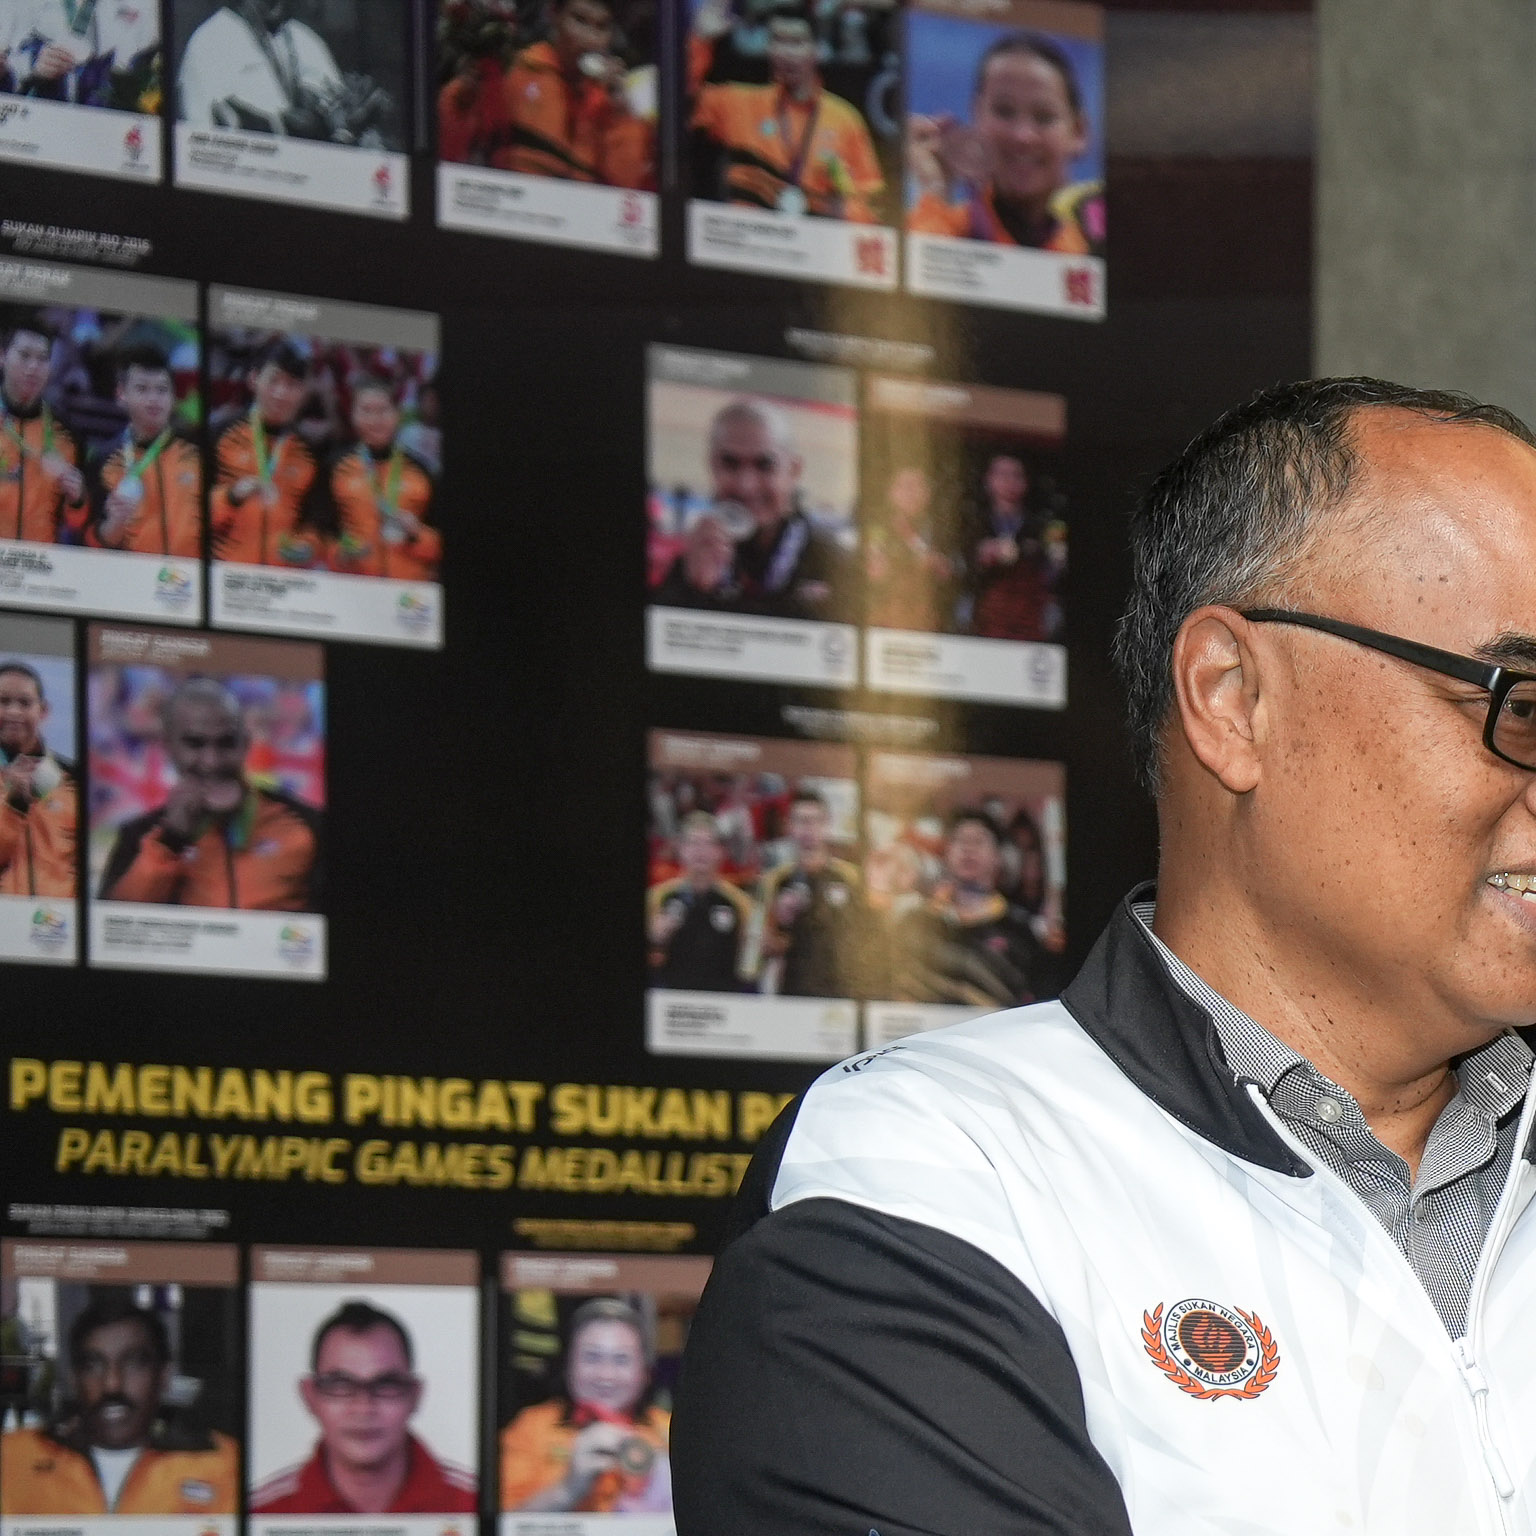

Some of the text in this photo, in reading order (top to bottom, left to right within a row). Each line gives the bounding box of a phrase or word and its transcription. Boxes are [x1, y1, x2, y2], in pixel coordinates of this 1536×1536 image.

[10, 1057, 333, 1124] PEMENANG
[343, 1073, 545, 1134] PINGAT
[550, 1083, 731, 1141] SUKAN
[55, 1127, 352, 1184] PARALYMPIC
[354, 1138, 516, 1190] GAMES
[1168, 1301, 1255, 1351] MAJLIS SUKAN NEGARA
[1194, 1366, 1249, 1383] MALAYSIA
